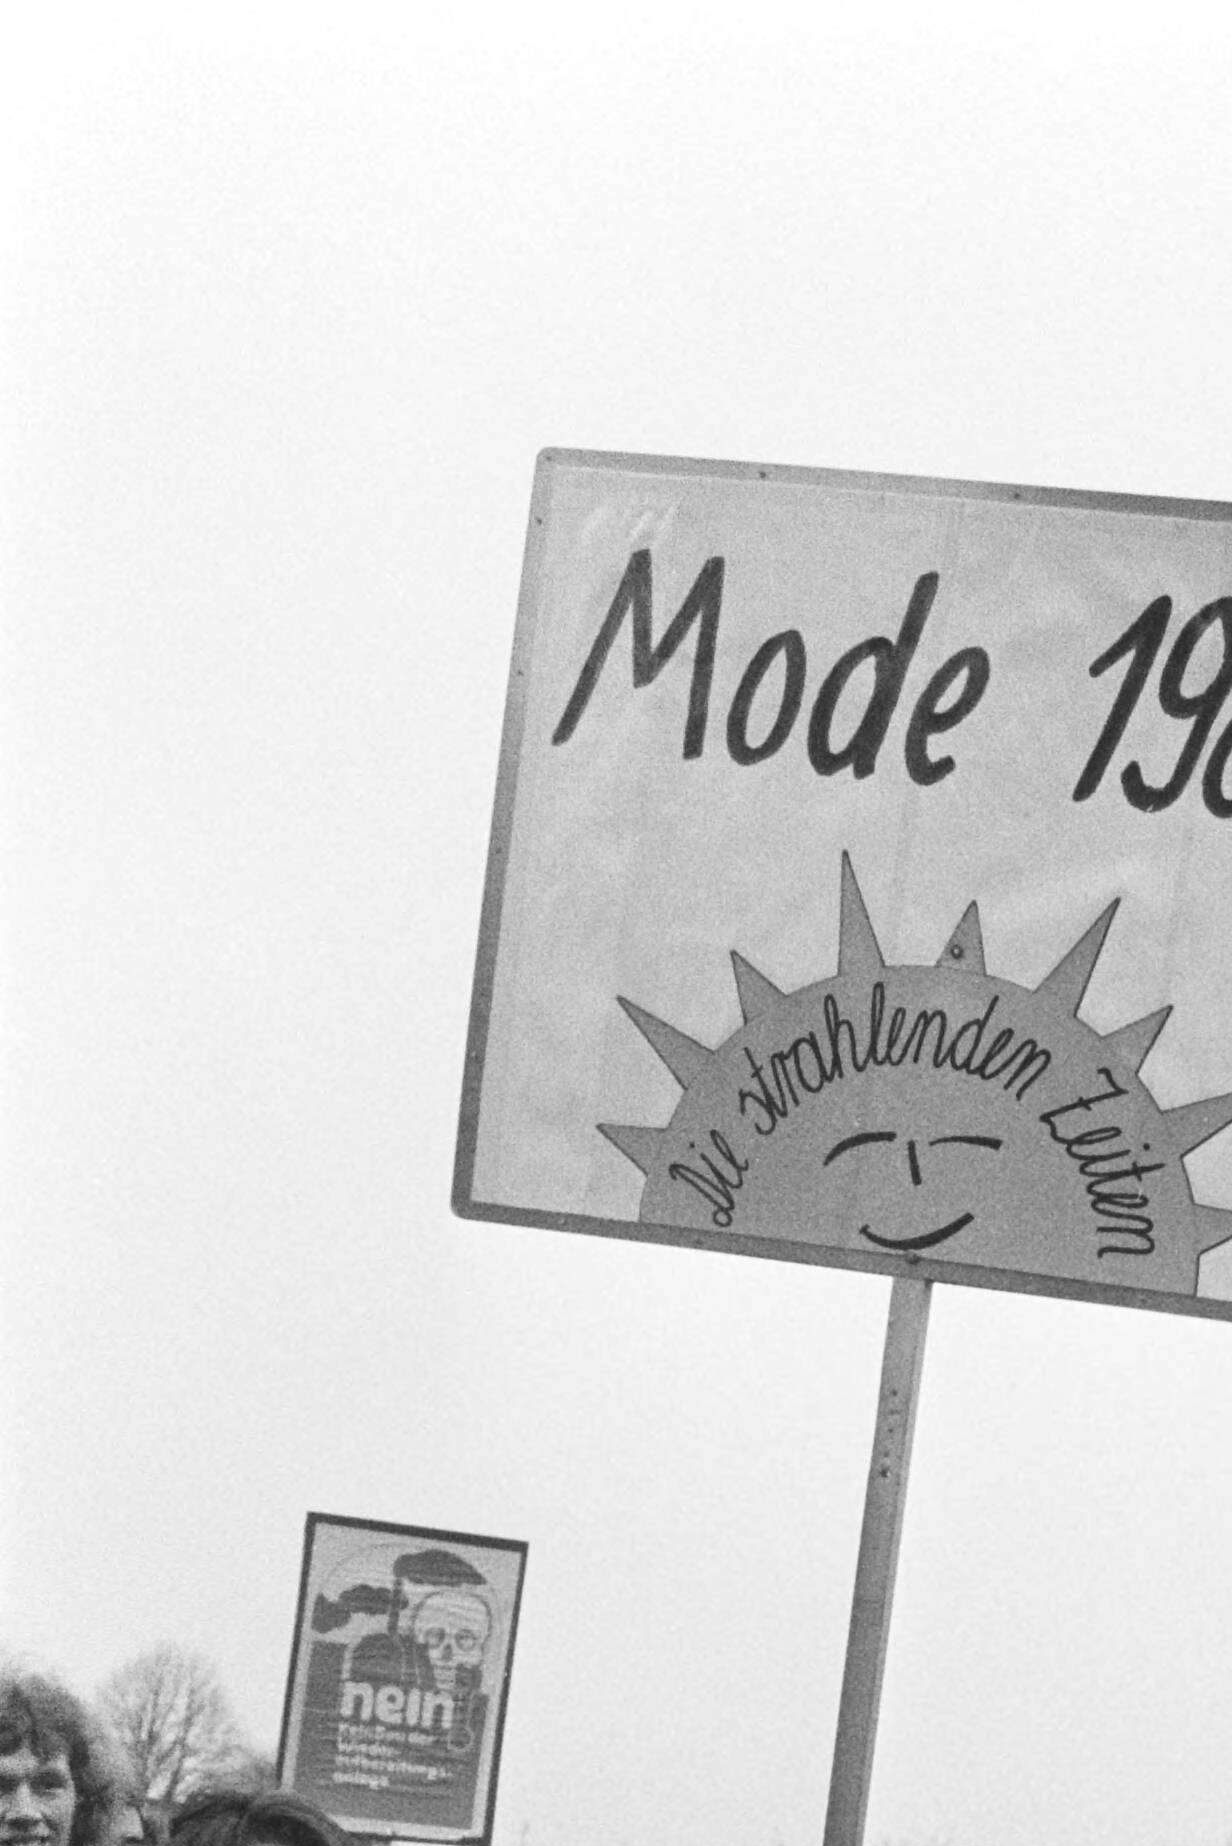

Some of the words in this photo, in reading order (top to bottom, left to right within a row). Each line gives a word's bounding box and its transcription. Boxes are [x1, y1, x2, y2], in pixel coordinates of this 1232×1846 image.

[551, 549, 991, 787] Mode
[667, 1128, 750, 1228] Die
[737, 980, 1053, 1137] strahlenden
[1038, 1066, 1166, 1259] Zeiten
[340, 1680, 455, 1729] nein
